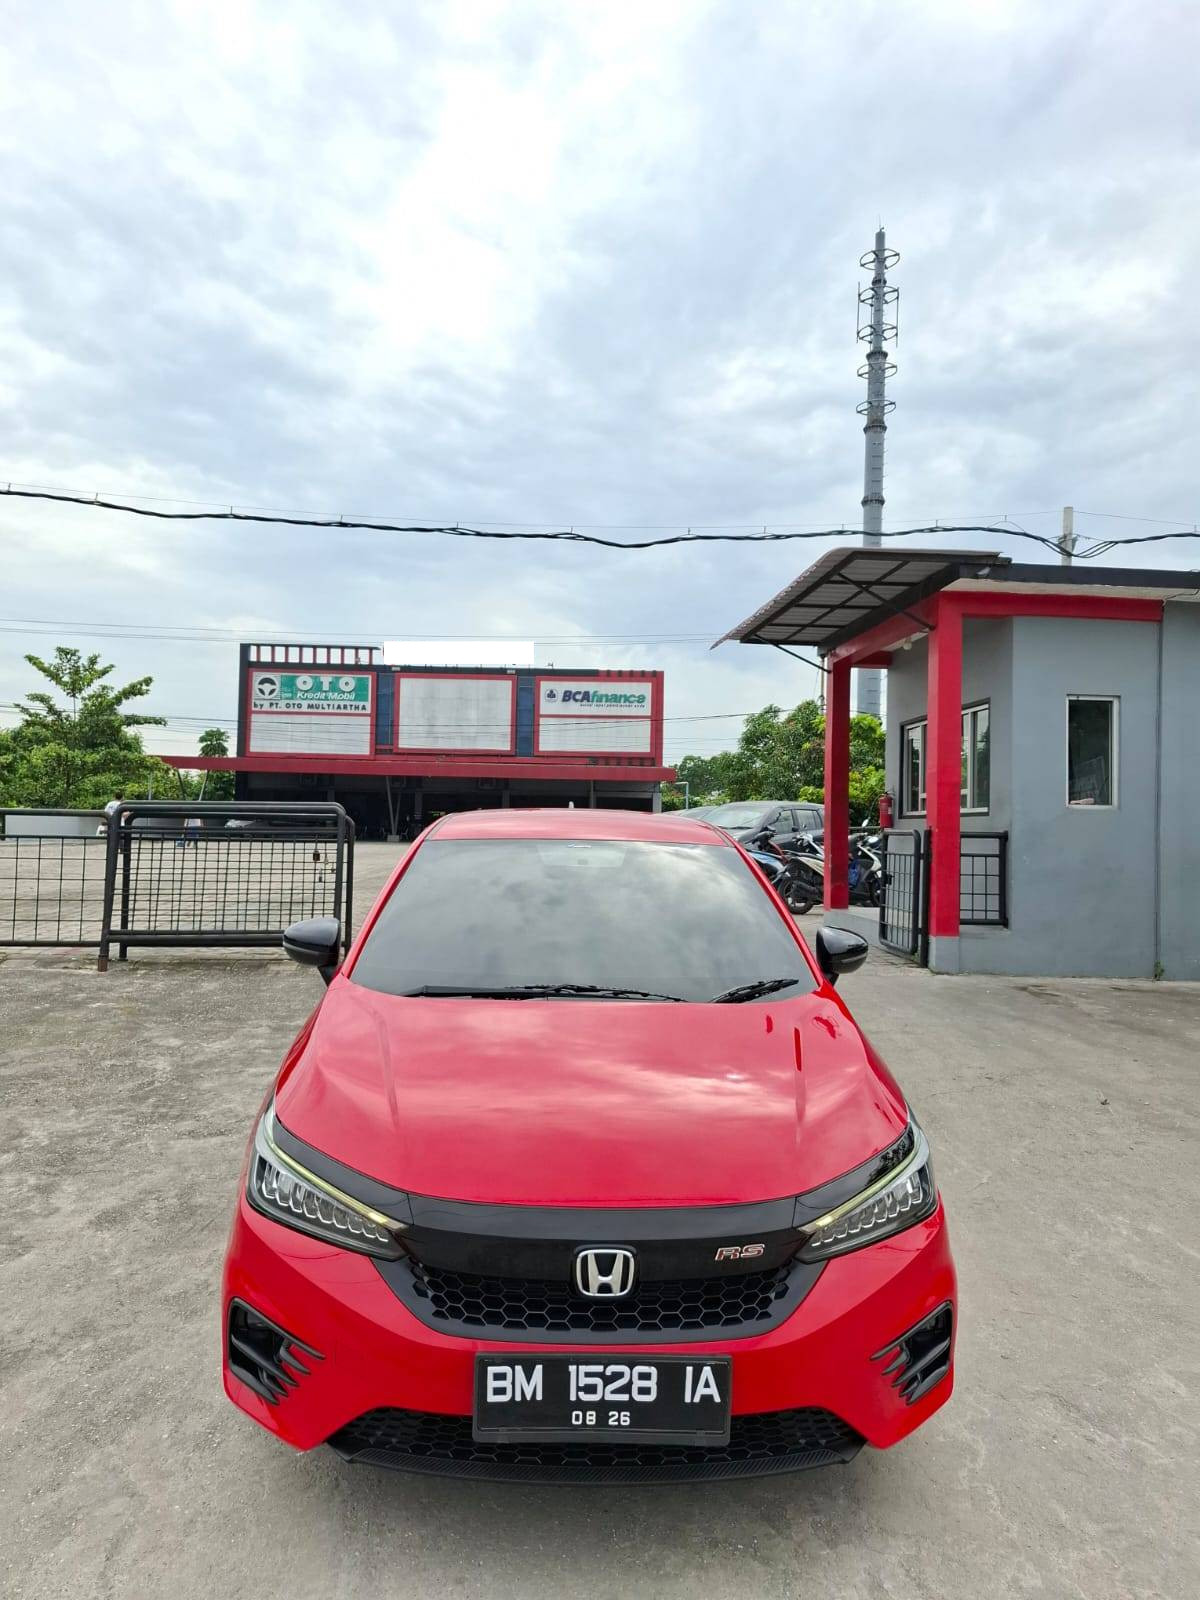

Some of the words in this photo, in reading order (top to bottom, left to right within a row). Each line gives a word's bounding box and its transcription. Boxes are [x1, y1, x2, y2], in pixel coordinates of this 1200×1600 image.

[296, 675, 356, 692] OTO
[296, 691, 326, 700] Kredit
[328, 692, 355, 701] Mobil
[253, 702, 264, 710] by
[307, 703, 367, 711] MULTIARTHA
[714, 1243, 765, 1261] RS
[486, 1364, 543, 1403] BM
[568, 1364, 658, 1402] 1528
[684, 1366, 721, 1403] IA
[571, 1410, 597, 1425] 08
[608, 1411, 631, 1426] 26
